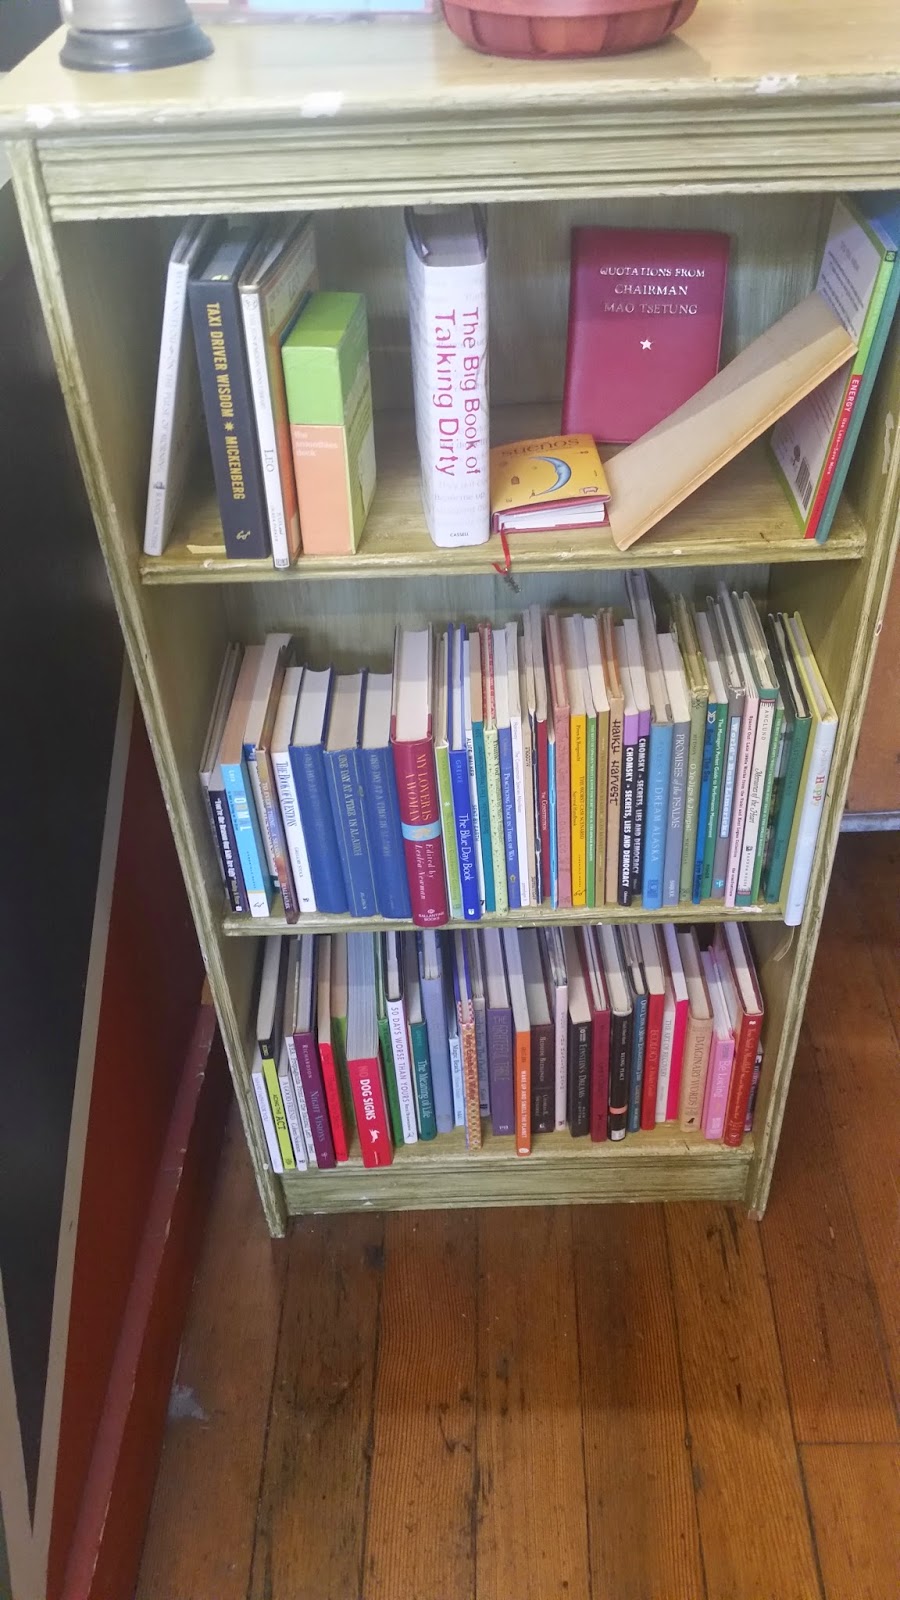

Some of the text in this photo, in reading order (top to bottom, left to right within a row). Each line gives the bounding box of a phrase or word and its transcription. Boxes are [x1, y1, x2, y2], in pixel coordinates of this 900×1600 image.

[600, 267, 705, 277] QUOTATIONS FROM
[615, 284, 688, 295] CHAIRMAN
[604, 302, 698, 314] MAO TSETUNG
[206, 303, 245, 500] TAXI DRIVER WISDOM MICKENBERG
[433, 309, 459, 477] Talking Dirty
[460, 307, 481, 475] The Big Book of
[844, 379, 860, 412] ENERGY
[264, 449, 274, 472] LEO
[761, 710, 769, 740] ANGLUND
[338, 754, 349, 768] ONE
[625, 747, 634, 782] CHOMSKY
[638, 738, 646, 772] CHOMSKY
[674, 734, 685, 777] PROMISES
[276, 761, 289, 774] THE
[340, 770, 351, 782] DAY
[689, 771, 696, 780] Ye
[262, 782, 268, 790] TO
[278, 774, 293, 790] BOOK
[343, 784, 352, 793] AT
[416, 754, 431, 821] MY LOVER IS
[673, 786, 681, 795] the
[721, 723, 738, 836] World's Best Limericks
[752, 768, 762, 792] Memories
[405, 781, 420, 821] WOMAN
[623, 790, 633, 819] SECRETS,
[635, 780, 644, 807] SECRETS,
[345, 799, 356, 816] TIME
[671, 797, 681, 829] PSALMS
[685, 805, 693, 831] Juleps!
[749, 807, 758, 823] Heart
[455, 760, 474, 881] GREIVE The Blue Day Book
[634, 824, 642, 837] AND
[651, 787, 663, 862] DREAM ALASKA
[623, 835, 631, 848] AND
[425, 844, 435, 867] Edited
[632, 838, 641, 874] DEMOCRACY
[621, 850, 630, 887] DEMOCRACY
[418, 871, 426, 899] Newman
[391, 1007, 398, 1015] 50
[392, 1018, 401, 1035] DAYS
[395, 1037, 404, 1060] WORSE
[649, 1029, 659, 1062] ECOLOGY
[398, 1063, 407, 1079] THAN
[417, 1060, 427, 1072] The
[578, 1044, 588, 1098] EINSTEIN'S DREAMS
[661, 1052, 669, 1077] RECOVERY
[688, 1036, 705, 1105] IMAGINARY WORDS
[720, 1061, 730, 1070] Be
[302, 1045, 325, 1142] RICHARDSON NIGHT VISIONS
[360, 1079, 372, 1096] DOG
[400, 1082, 409, 1102] YOURS
[418, 1073, 430, 1099] Meaning
[363, 1098, 376, 1120] SIGNS
[422, 1107, 432, 1118] Life
[276, 1116, 286, 1130] ACT
